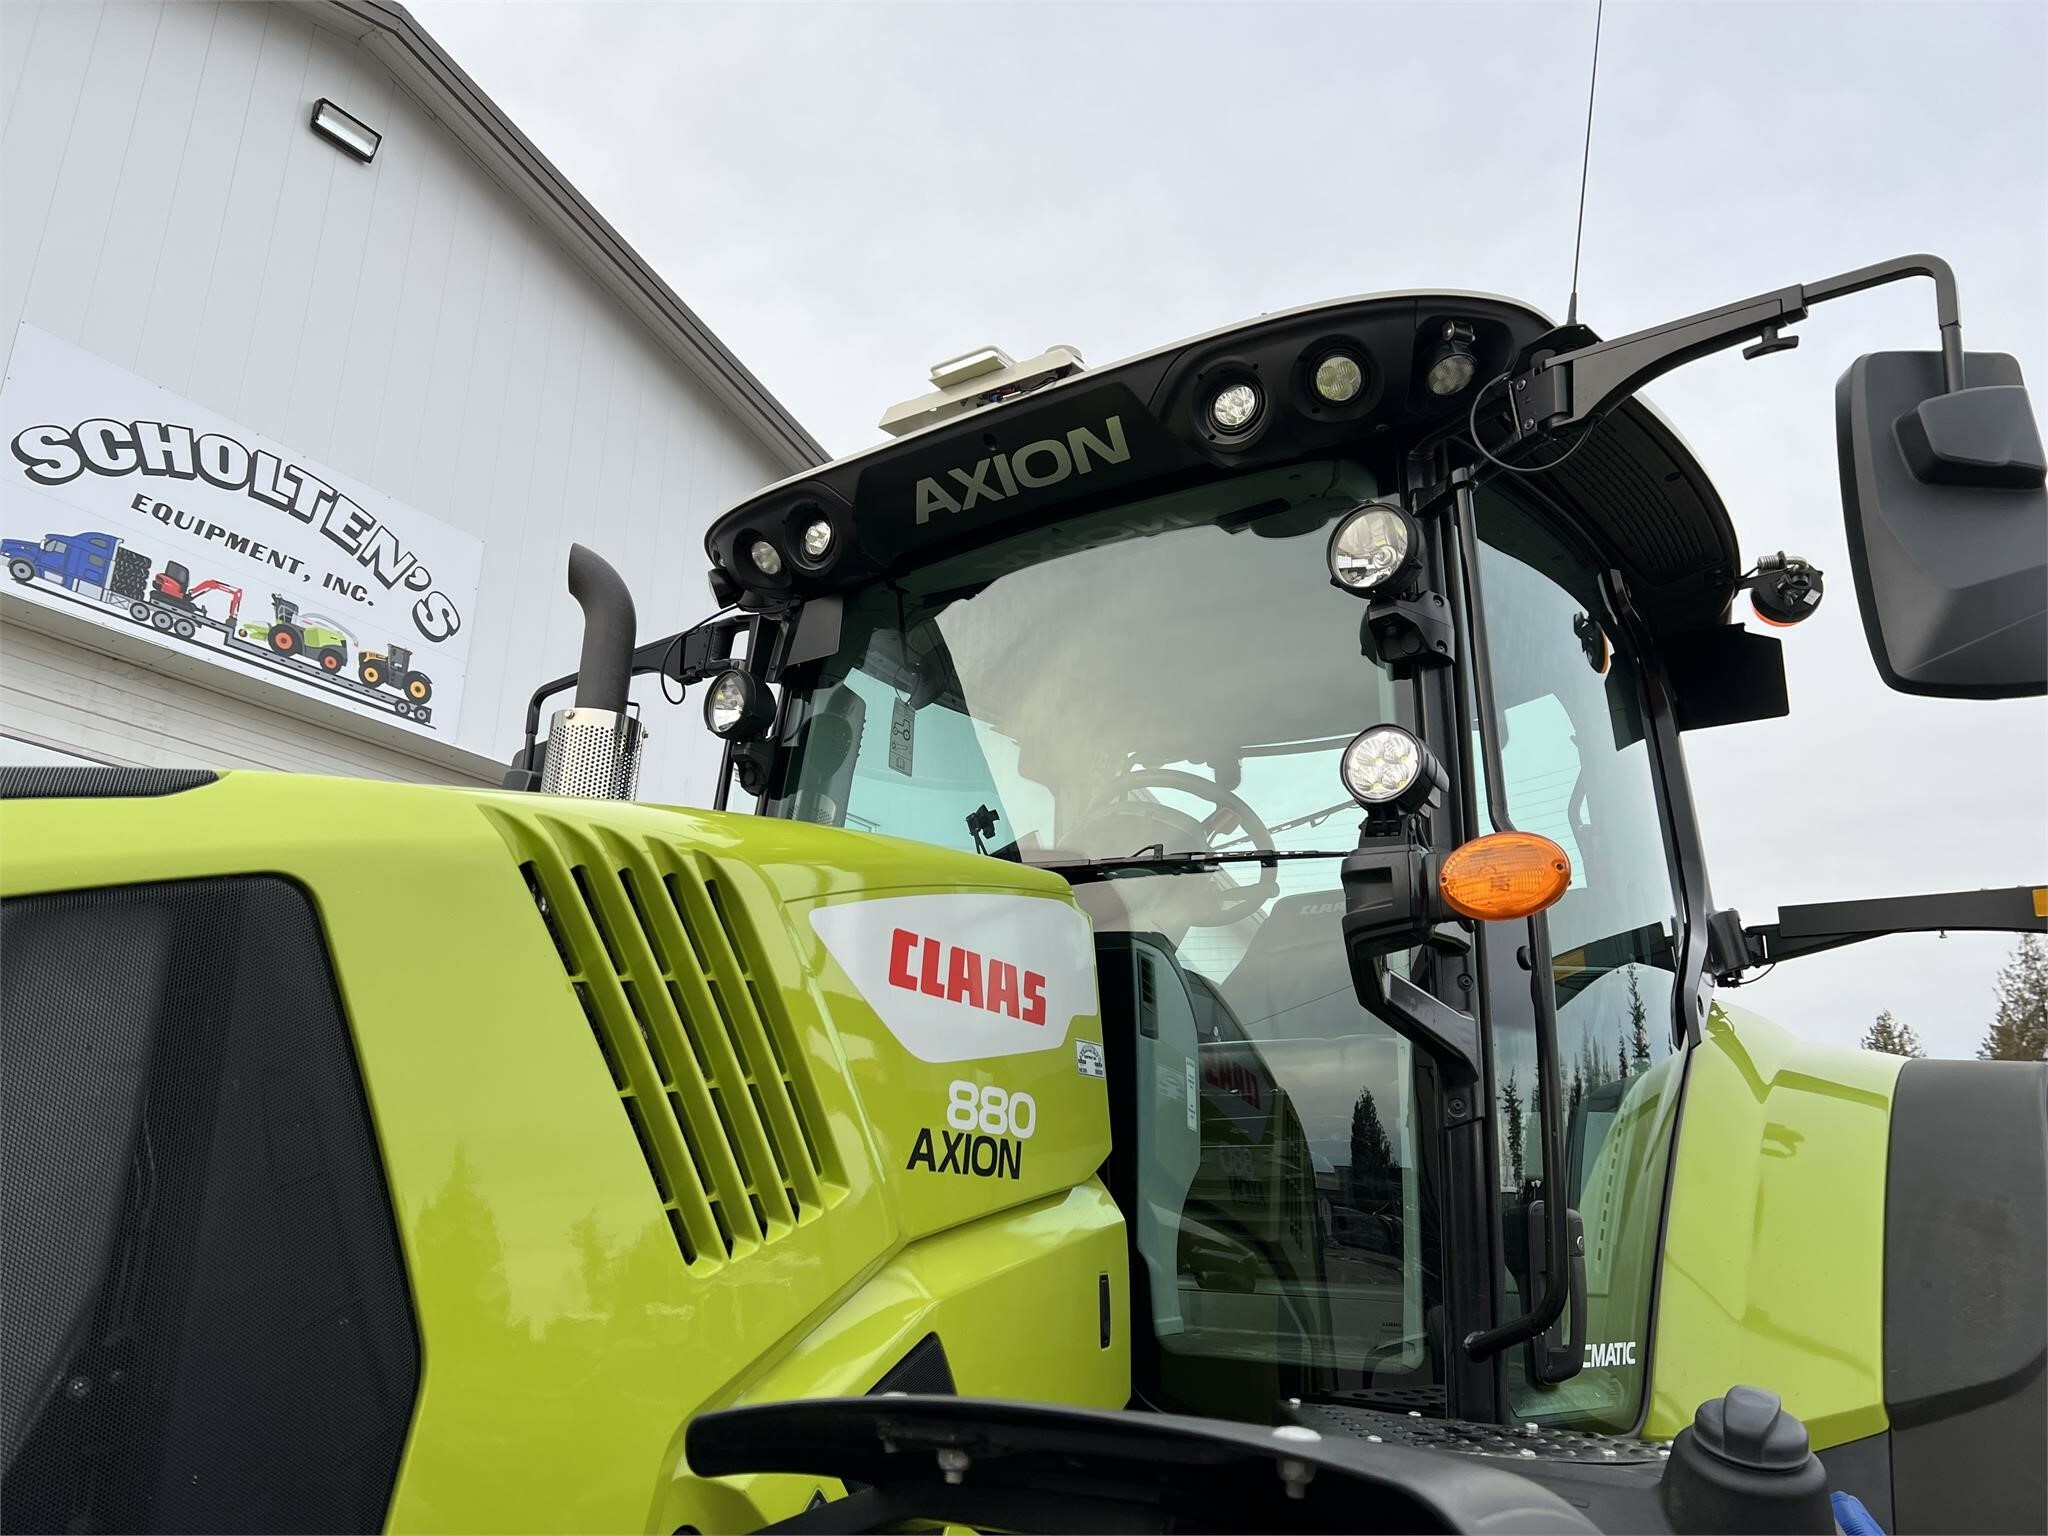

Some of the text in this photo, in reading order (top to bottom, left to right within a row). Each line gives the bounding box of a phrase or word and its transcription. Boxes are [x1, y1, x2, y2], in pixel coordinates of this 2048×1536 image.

[916, 415, 1131, 525] AXION
[10, 418, 461, 642] SCHOLTEN'S
[131, 493, 375, 607] EQUIPMENT, INC.
[1299, 902, 1346, 915] CLAA
[889, 928, 1046, 1026] CLAAS
[906, 1128, 1022, 1180] AXION
[947, 1080, 1036, 1139] 880
